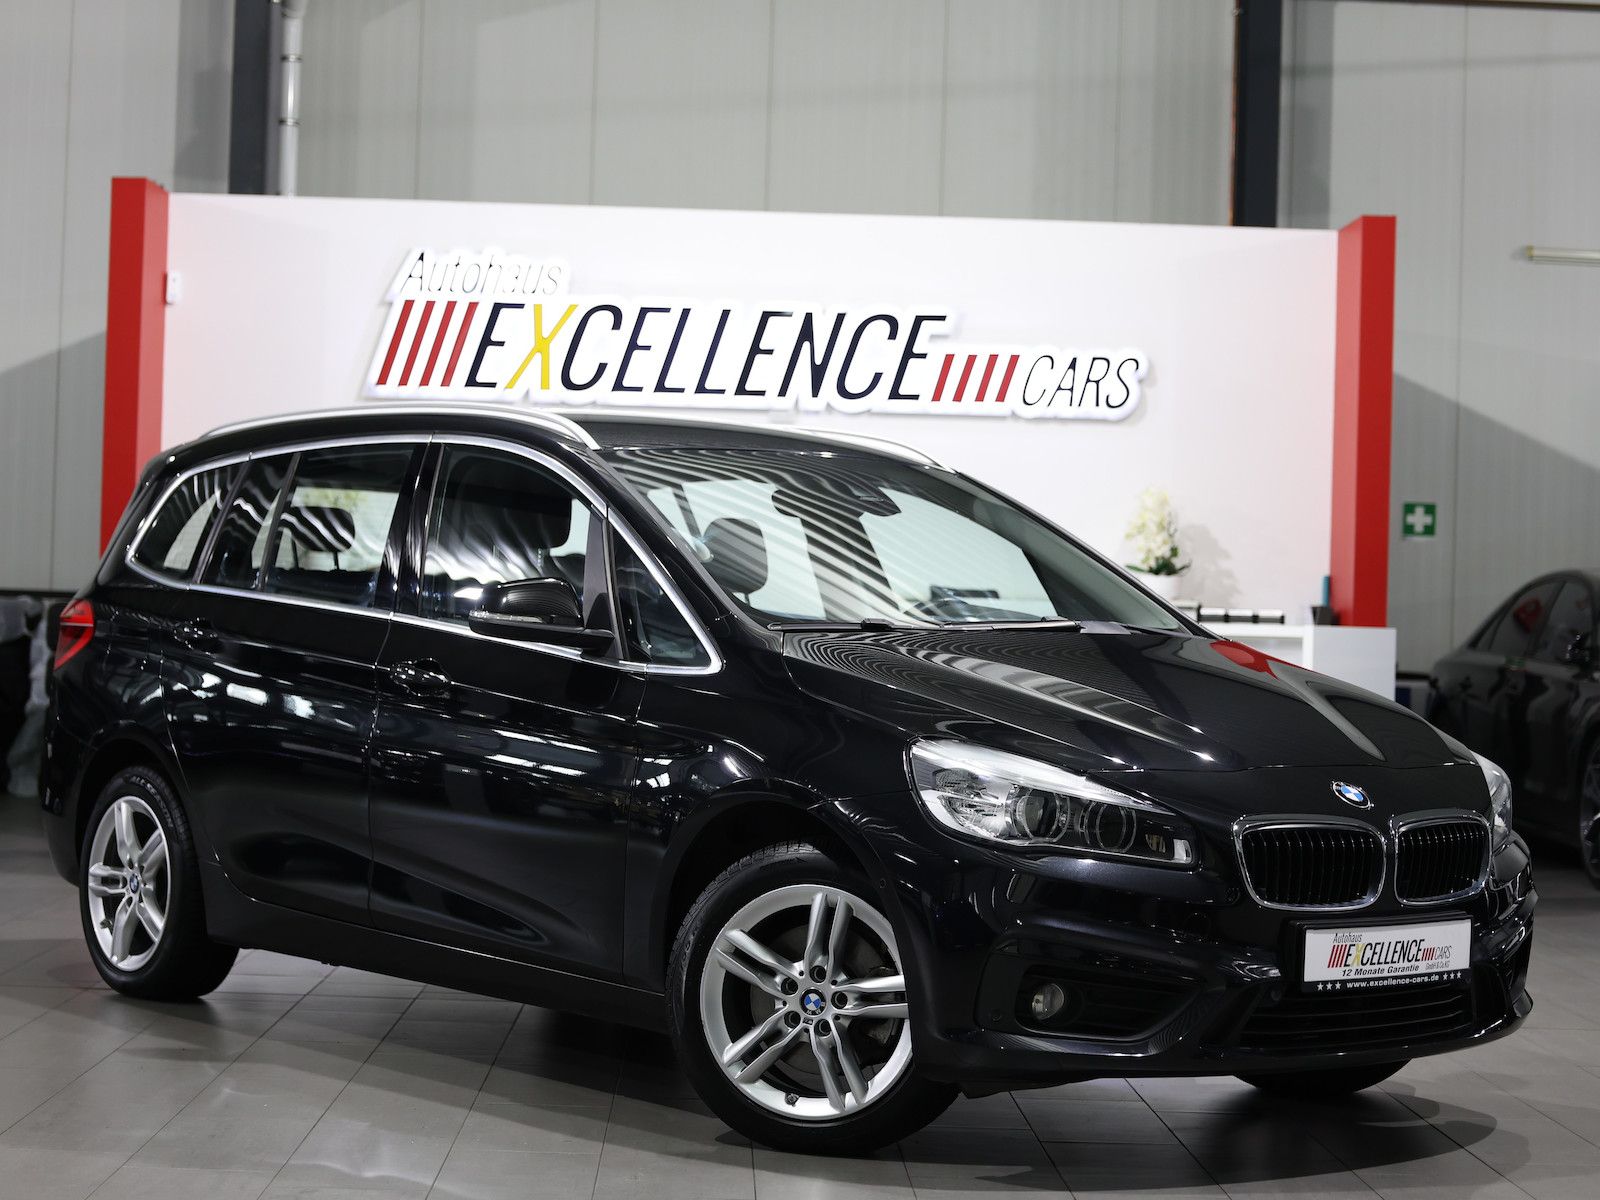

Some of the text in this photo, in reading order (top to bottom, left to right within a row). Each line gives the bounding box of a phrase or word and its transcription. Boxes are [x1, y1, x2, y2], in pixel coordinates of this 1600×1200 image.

[400, 250, 563, 295] Autohaus
[464, 302, 1140, 408] EXCELLENCE CARS
[1332, 932, 1363, 944] Autohaus
[1343, 938, 1425, 968] EXCELLENCE
[1434, 945, 1453, 961] CARS
[1342, 968, 1352, 977] 12
[1354, 966, 1385, 976] Monate
[1387, 964, 1420, 974] Garantie
[1346, 974, 1440, 989] www.excellence-cars.de
